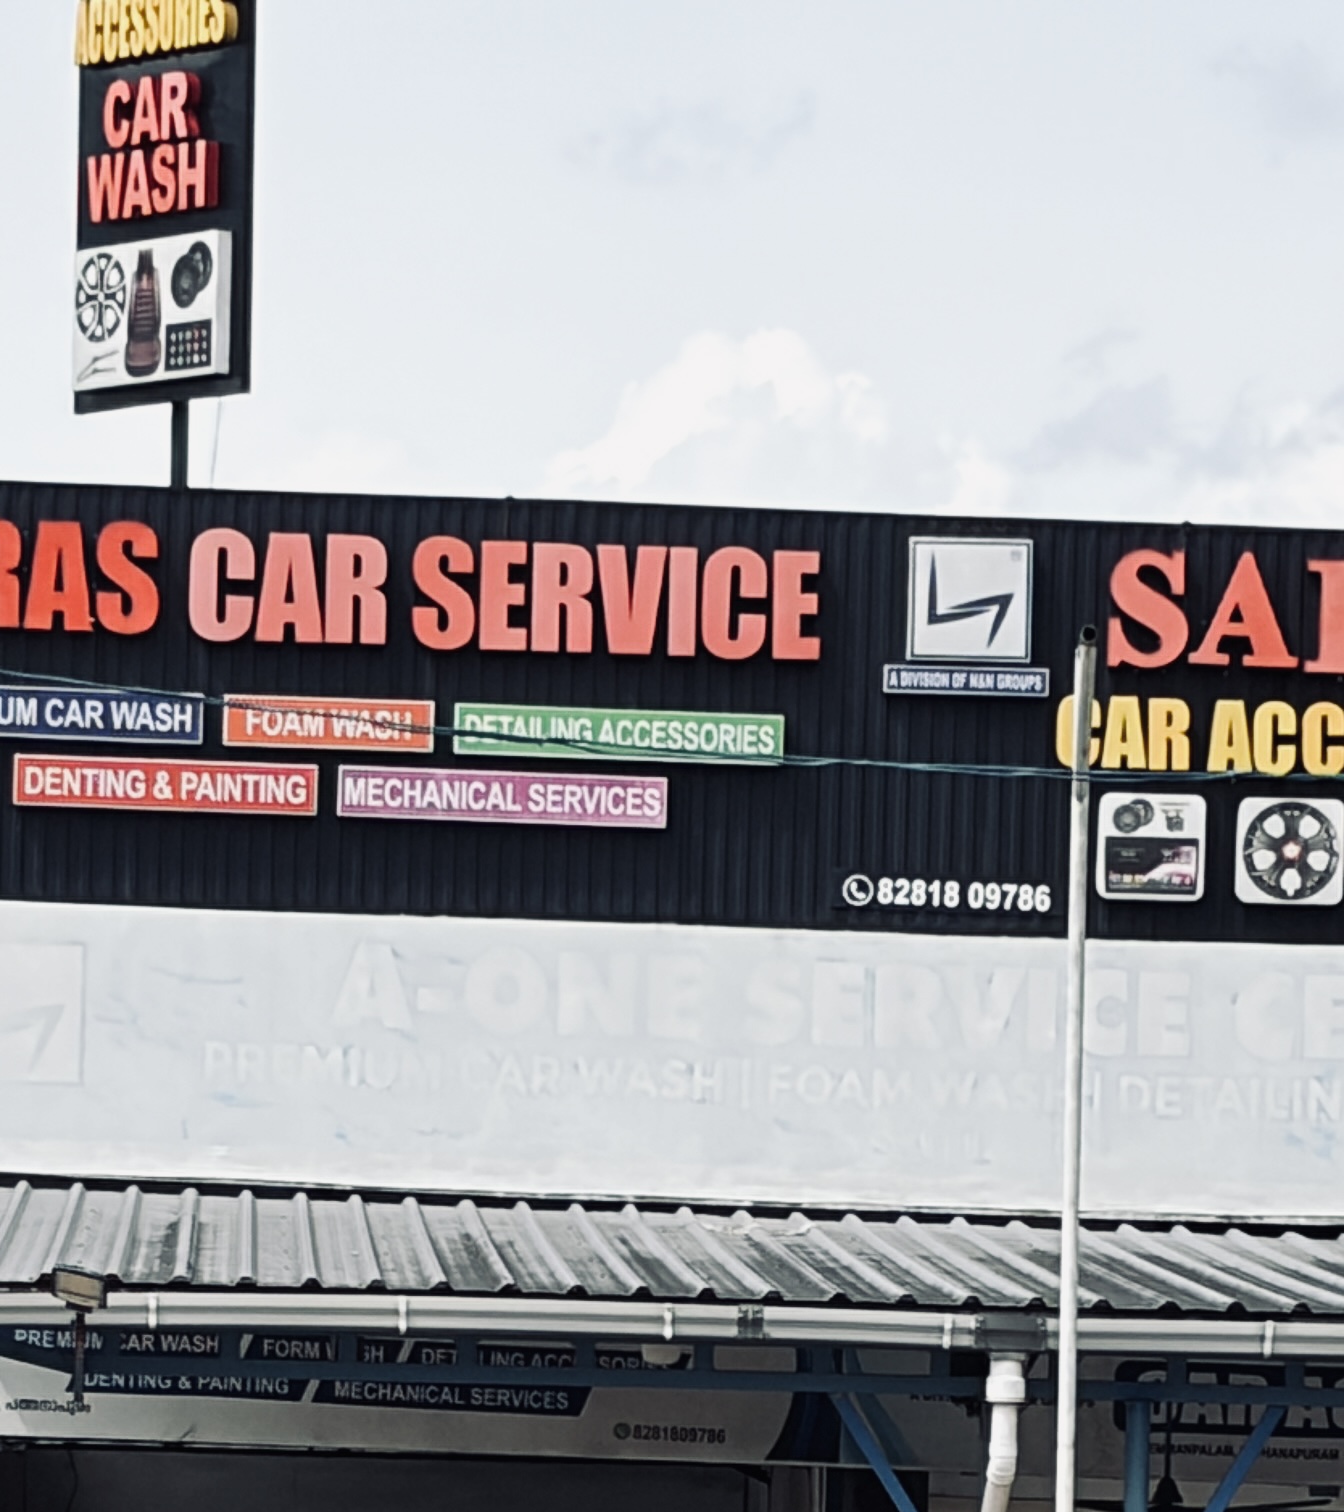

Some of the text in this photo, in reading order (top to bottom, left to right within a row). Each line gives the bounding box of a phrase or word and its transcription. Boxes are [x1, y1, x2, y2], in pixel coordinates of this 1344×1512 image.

[103, 71, 200, 149] CAR
[87, 139, 219, 223] WASH
[188, 527, 388, 645] CAR
[411, 535, 822, 661] SERVICE
[900, 671, 949, 690] DIVISION
[952, 673, 967, 688] OF
[996, 674, 1042, 692] GROUPS
[44, 698, 103, 730] CAR
[110, 701, 193, 734] WASH
[246, 710, 412, 742] FOAM WASH
[464, 714, 776, 755] DETAILING ACCESSORIES
[1056, 694, 1191, 771] CAR
[24, 765, 308, 805] DENTING & PAINTING
[344, 777, 663, 819] MECHANICAL SERVICES
[876, 877, 1052, 913] 82818 09786
[331, 940, 710, 1040] A-ONE
[576, 1054, 722, 1103] WASH
[160, 1335, 220, 1354] WASH
[262, 1339, 317, 1359] FORM
[84, 1373, 172, 1391] DENTING
[197, 1375, 290, 1394] PAINTING
[333, 1380, 569, 1410] MECHANICAL SERVICES
[632, 1424, 726, 1444] 8281809786
